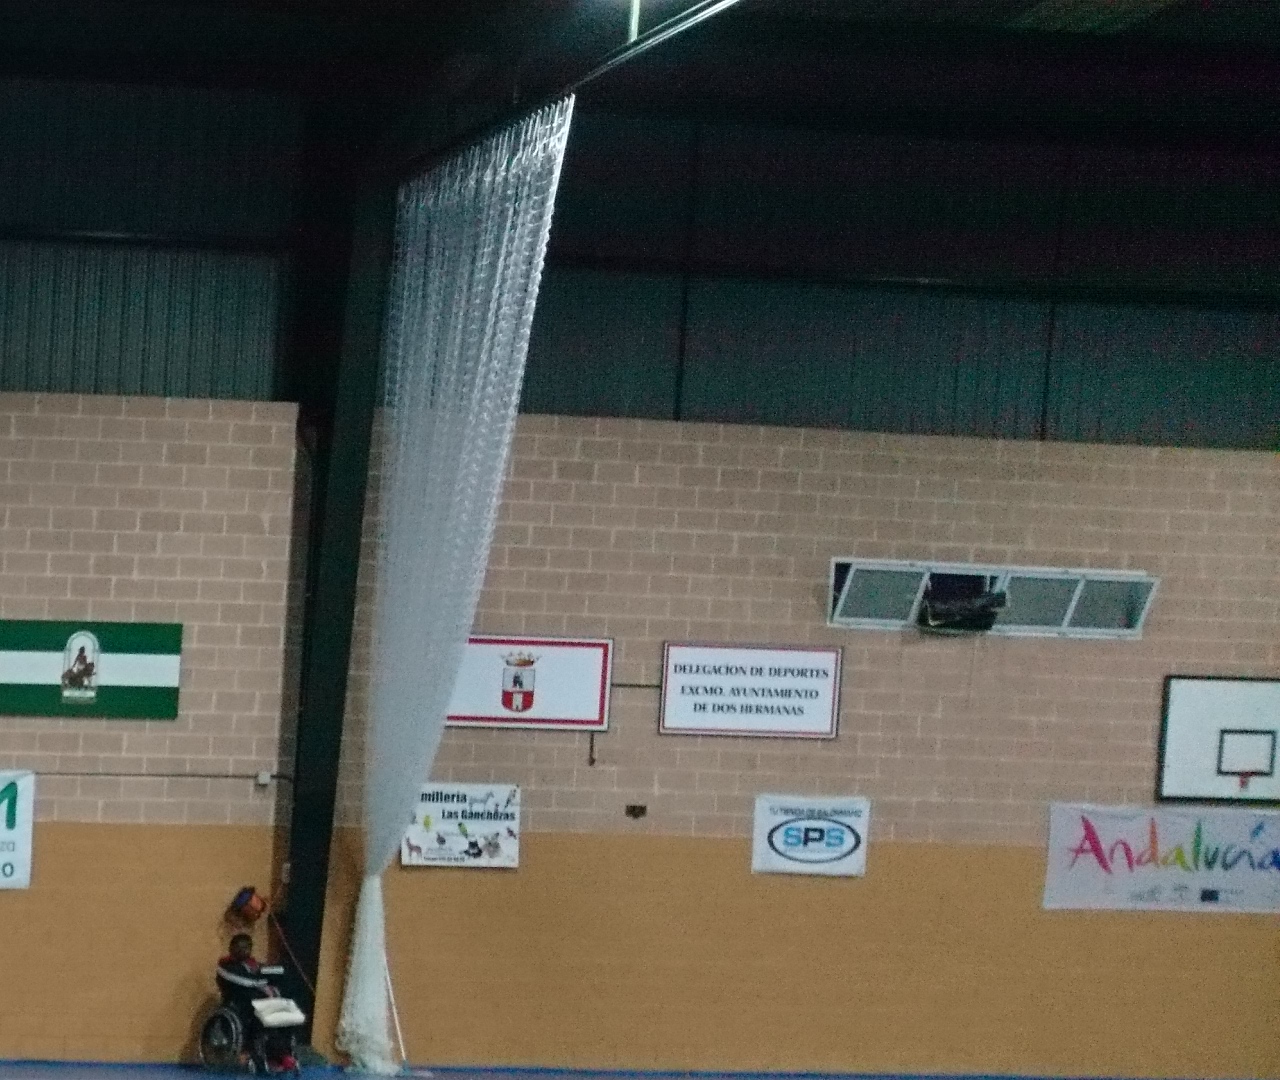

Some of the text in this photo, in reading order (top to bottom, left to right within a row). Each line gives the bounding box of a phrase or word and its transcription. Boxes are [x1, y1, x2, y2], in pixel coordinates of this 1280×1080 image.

[749, 666, 765, 678] DE
[768, 666, 830, 679] DEPORTES
[728, 687, 820, 700] AYUNTAMIENTO
[693, 702, 806, 716] DE DOS HERMANAS
[441, 808, 459, 820] Las
[782, 826, 846, 848] SPS
